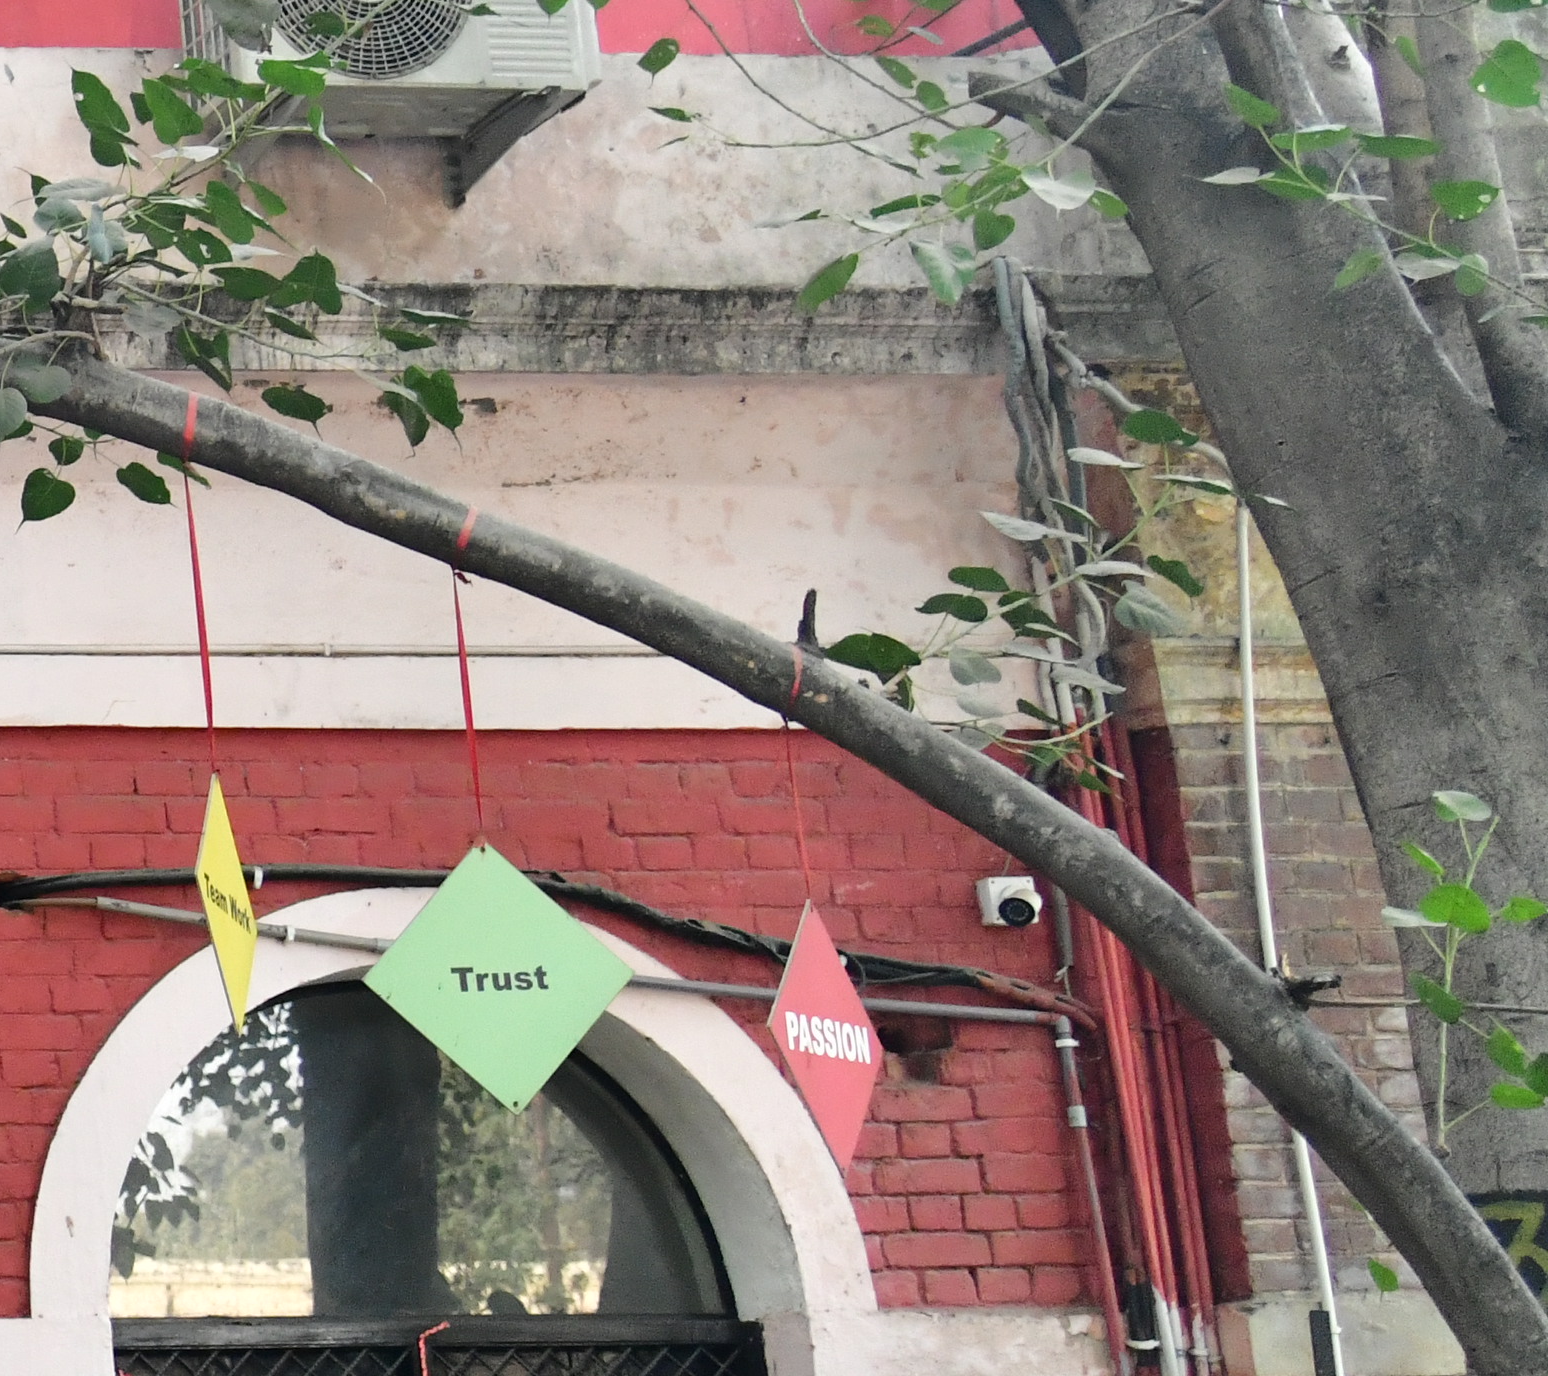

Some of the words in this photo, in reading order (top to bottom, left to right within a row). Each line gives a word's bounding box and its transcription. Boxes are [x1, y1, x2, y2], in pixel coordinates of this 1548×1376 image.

[204, 872, 228, 914] Team
[229, 893, 251, 934] Work
[451, 966, 548, 992] Trust
[785, 1012, 872, 1064] PASSION
